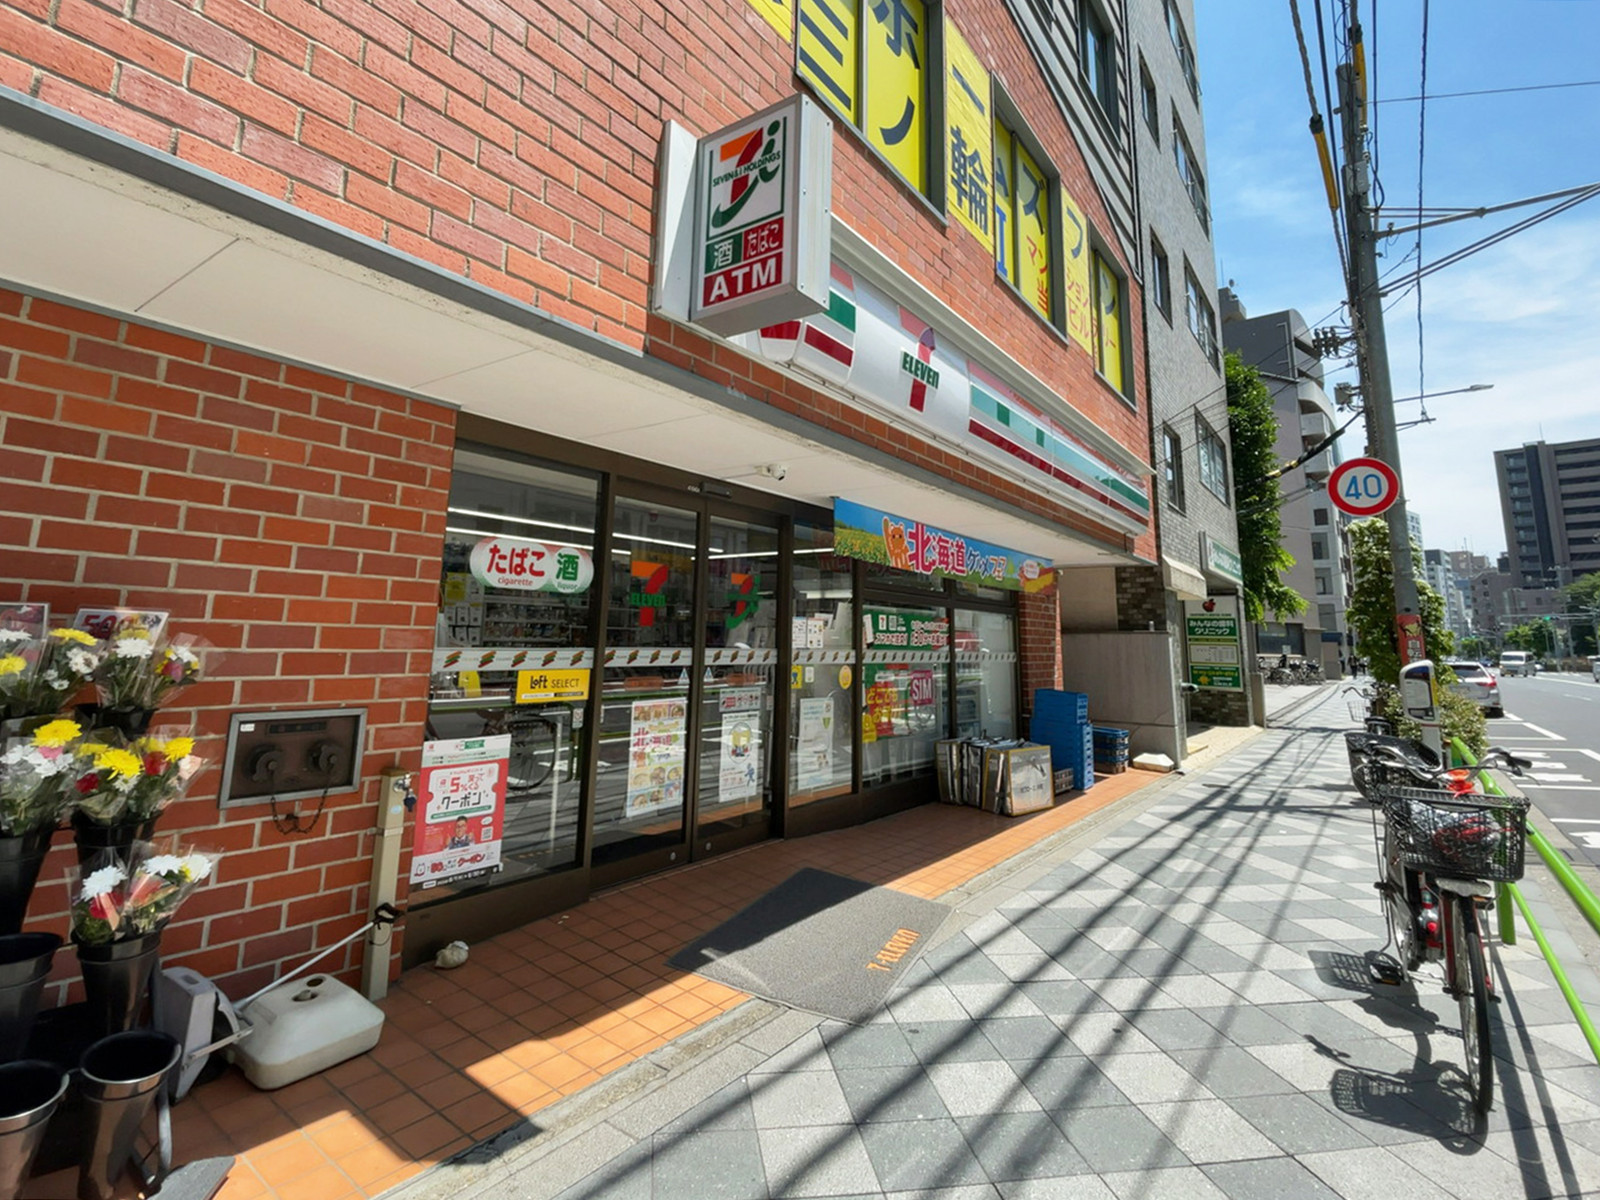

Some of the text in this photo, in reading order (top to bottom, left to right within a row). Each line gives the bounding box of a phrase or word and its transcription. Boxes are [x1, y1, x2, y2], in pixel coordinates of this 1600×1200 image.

[743, 150, 781, 176] HOLDINGS
[713, 224, 779, 269] 酒 たばこ
[709, 257, 776, 302] ATM
[1345, 473, 1382, 500] 40
[487, 544, 580, 581] たばこ 酒
[498, 577, 534, 587] cigarette
[551, 679, 580, 689] SELECT
[912, 678, 932, 701] SIM
[441, 791, 482, 810] クーポン
